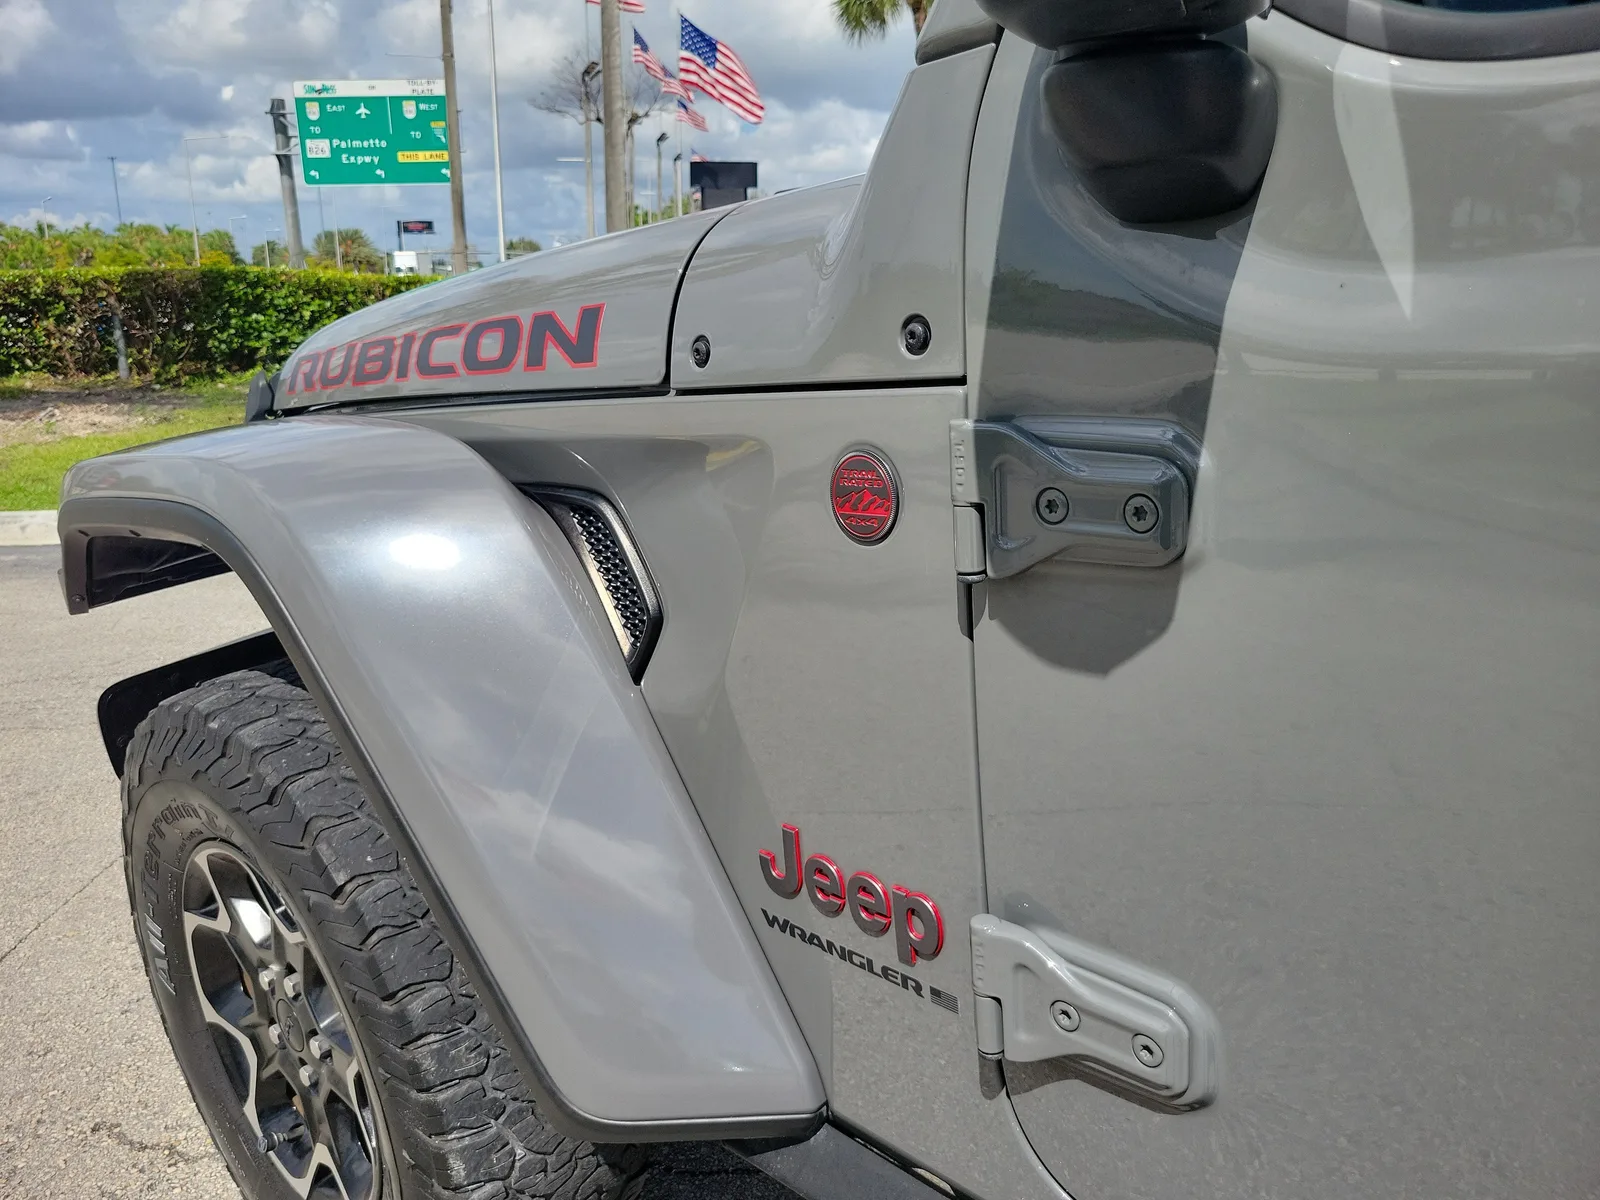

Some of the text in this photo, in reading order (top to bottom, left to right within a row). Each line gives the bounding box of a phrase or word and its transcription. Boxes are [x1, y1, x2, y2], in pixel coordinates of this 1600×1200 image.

[326, 104, 346, 113] EAST
[418, 103, 438, 111] WEST
[309, 126, 321, 134] TO
[410, 131, 422, 139] TO
[332, 138, 388, 149] Palmetto
[341, 153, 380, 166] Expwy
[400, 152, 447, 161] THIS LANE
[286, 302, 606, 395] RUBICON
[841, 468, 880, 479] TRAIL
[839, 477, 884, 488] RATED
[758, 822, 946, 967] Jeep
[760, 907, 925, 999] WRANGLER
